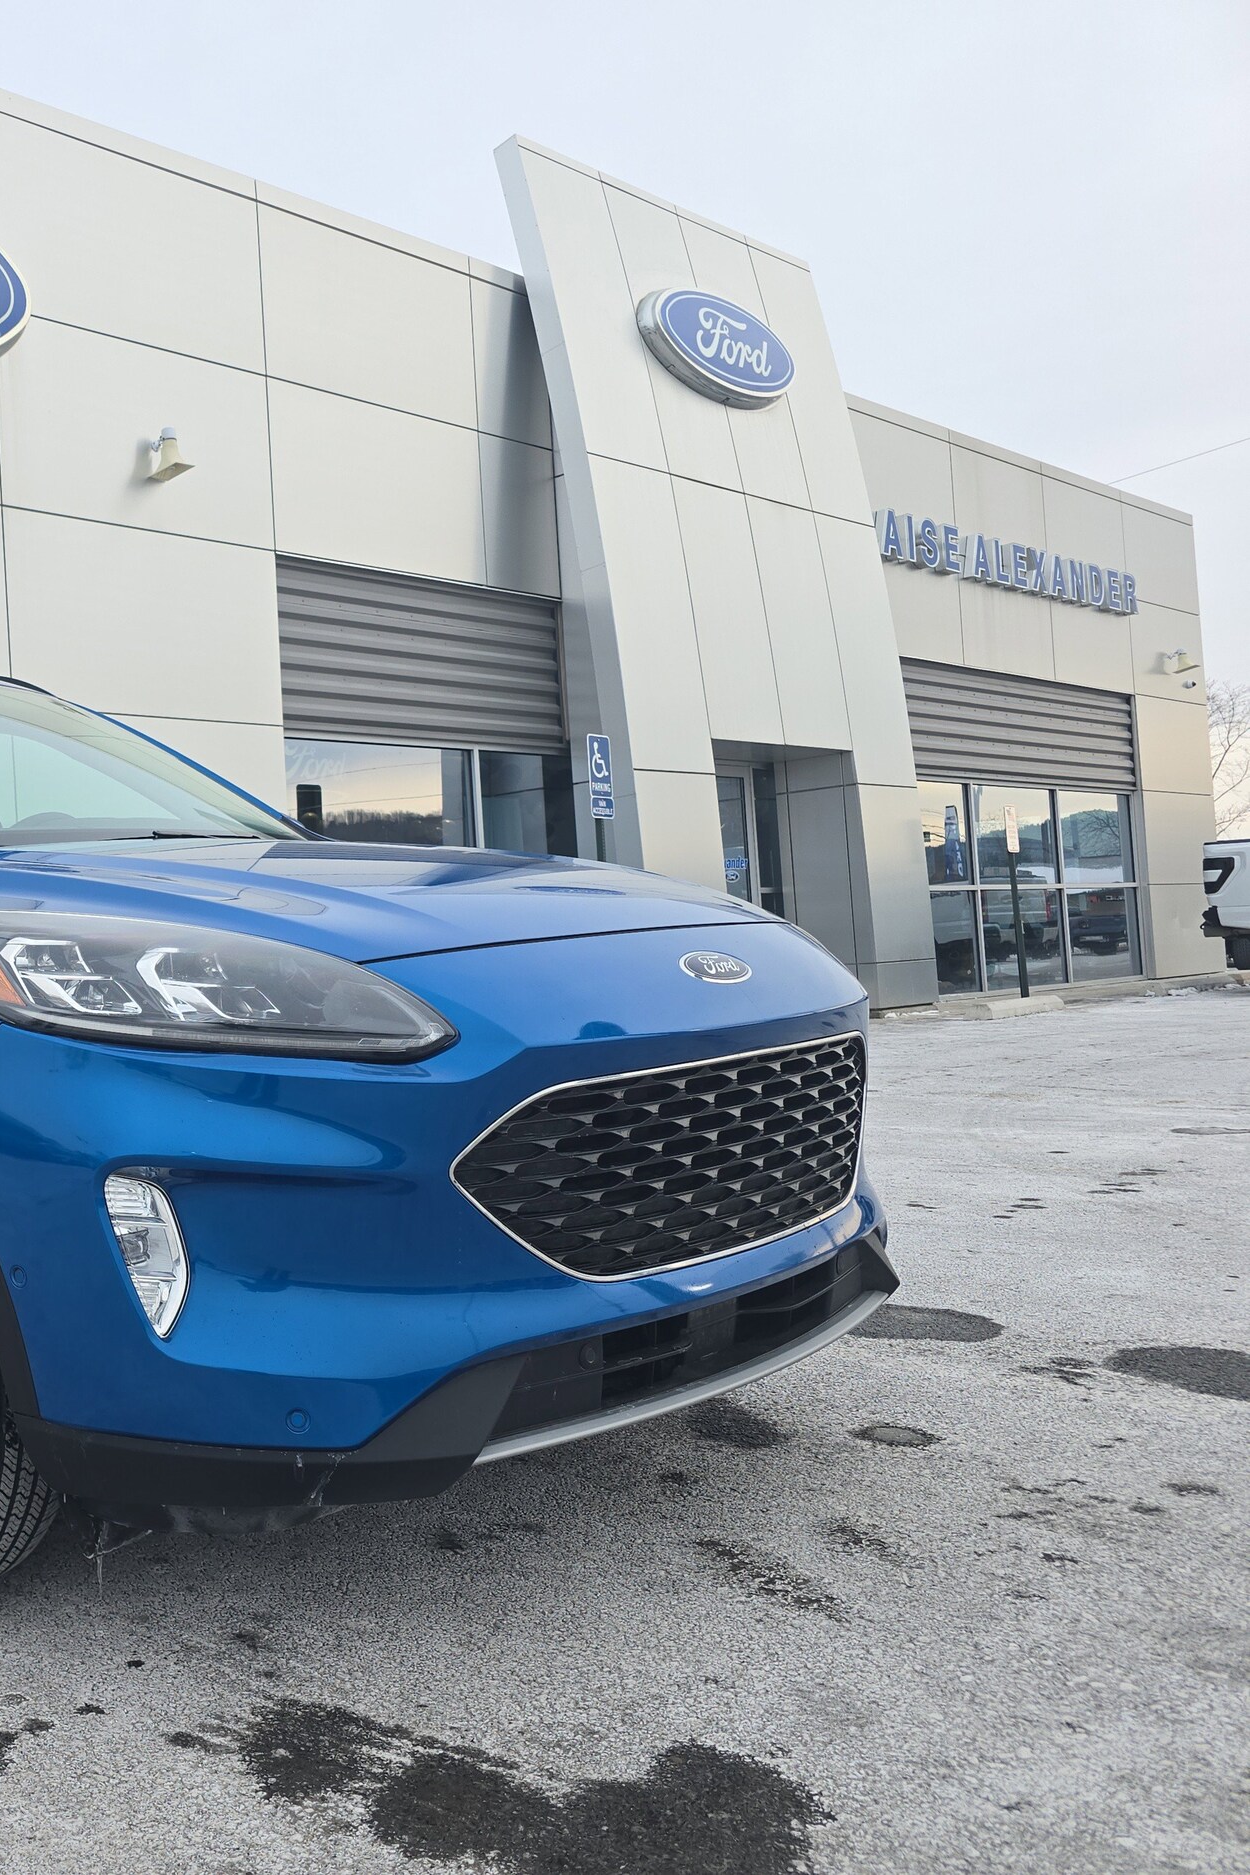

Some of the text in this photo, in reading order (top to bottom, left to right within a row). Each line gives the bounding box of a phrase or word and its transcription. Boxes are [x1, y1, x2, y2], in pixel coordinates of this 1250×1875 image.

[696, 307, 771, 377] Ford
[969, 533, 1139, 615] ALEXANDER
[725, 856, 748, 870] ander
[698, 955, 740, 975] Ford
